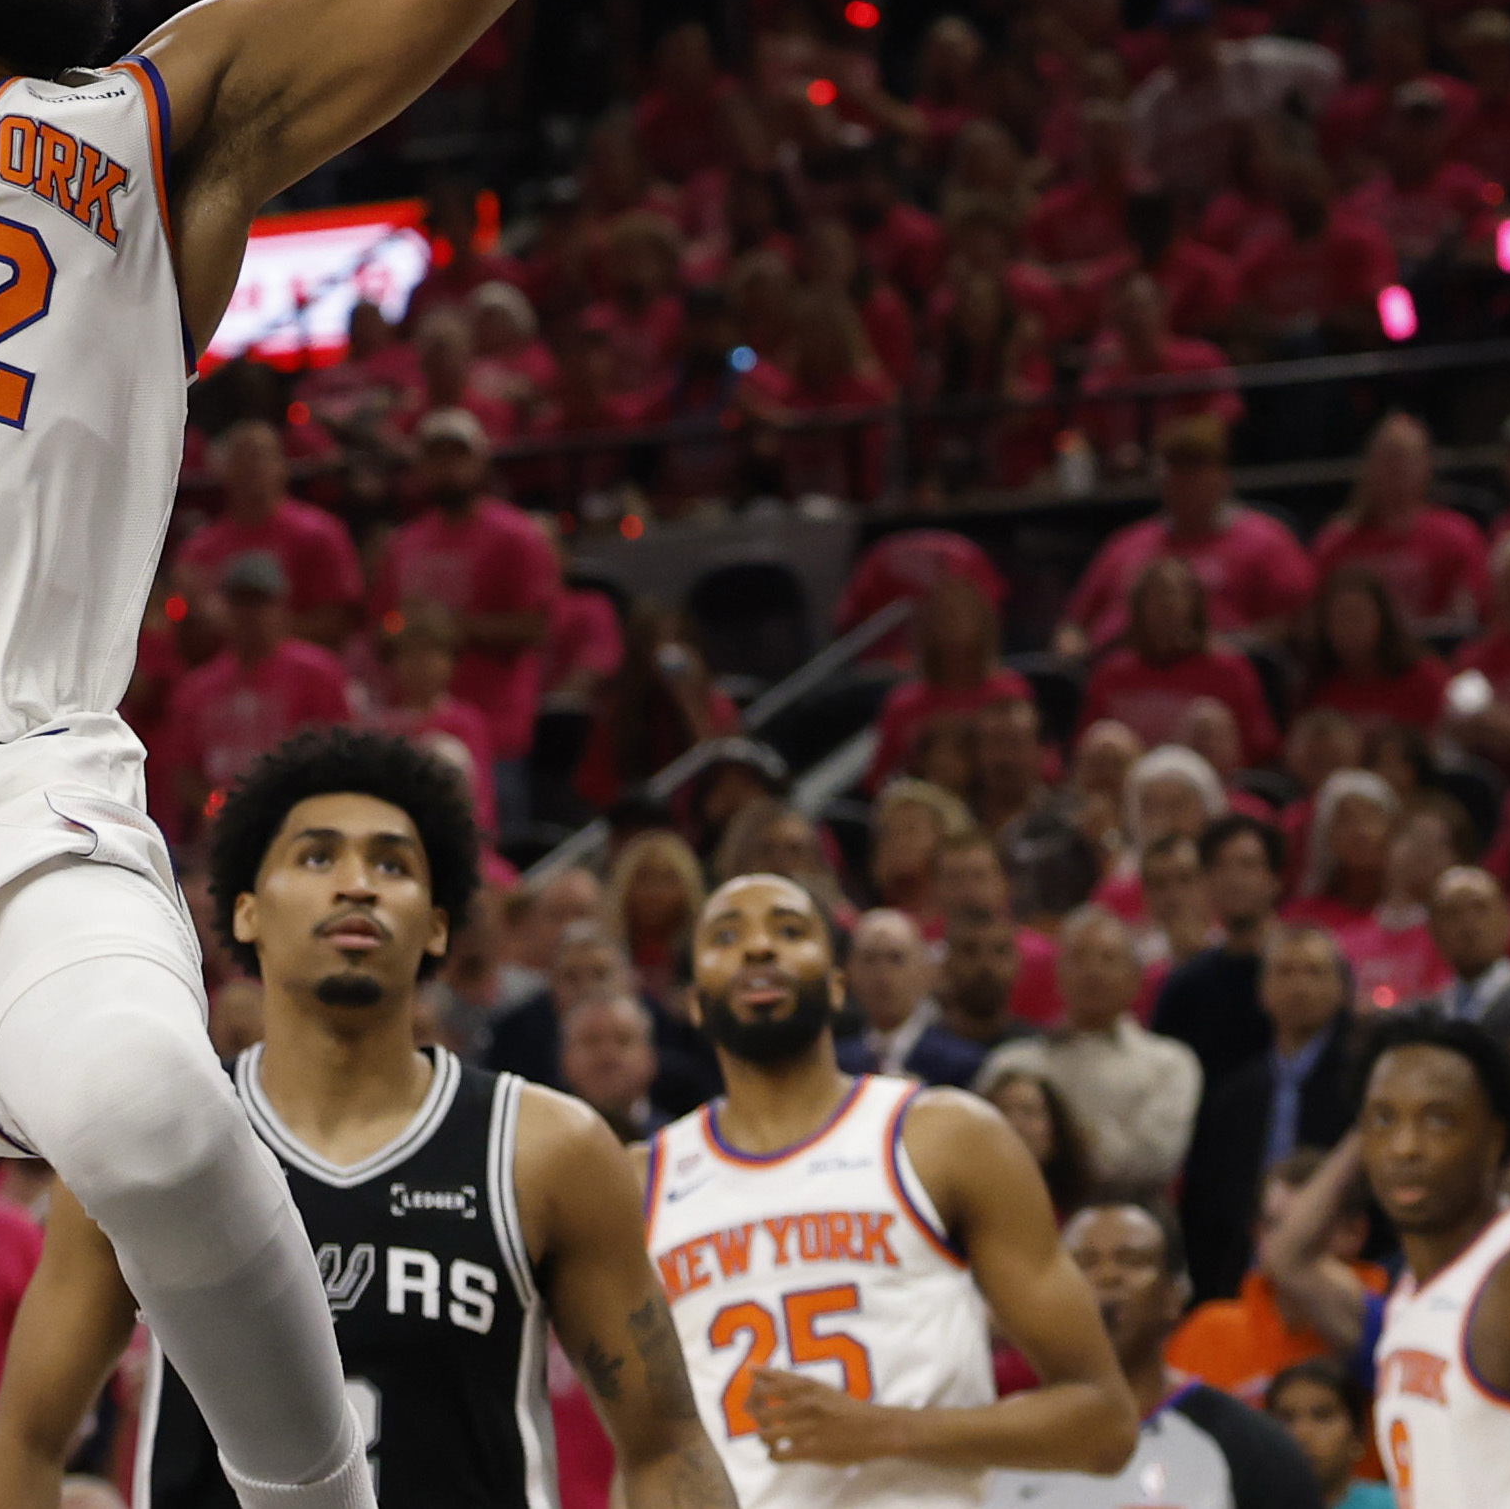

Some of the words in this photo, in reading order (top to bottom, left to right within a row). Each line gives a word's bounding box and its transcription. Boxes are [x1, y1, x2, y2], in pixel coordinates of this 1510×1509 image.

[657, 1225, 754, 1305] NEW
[763, 1211, 901, 1267] YORK
[708, 1283, 874, 1439] 25
